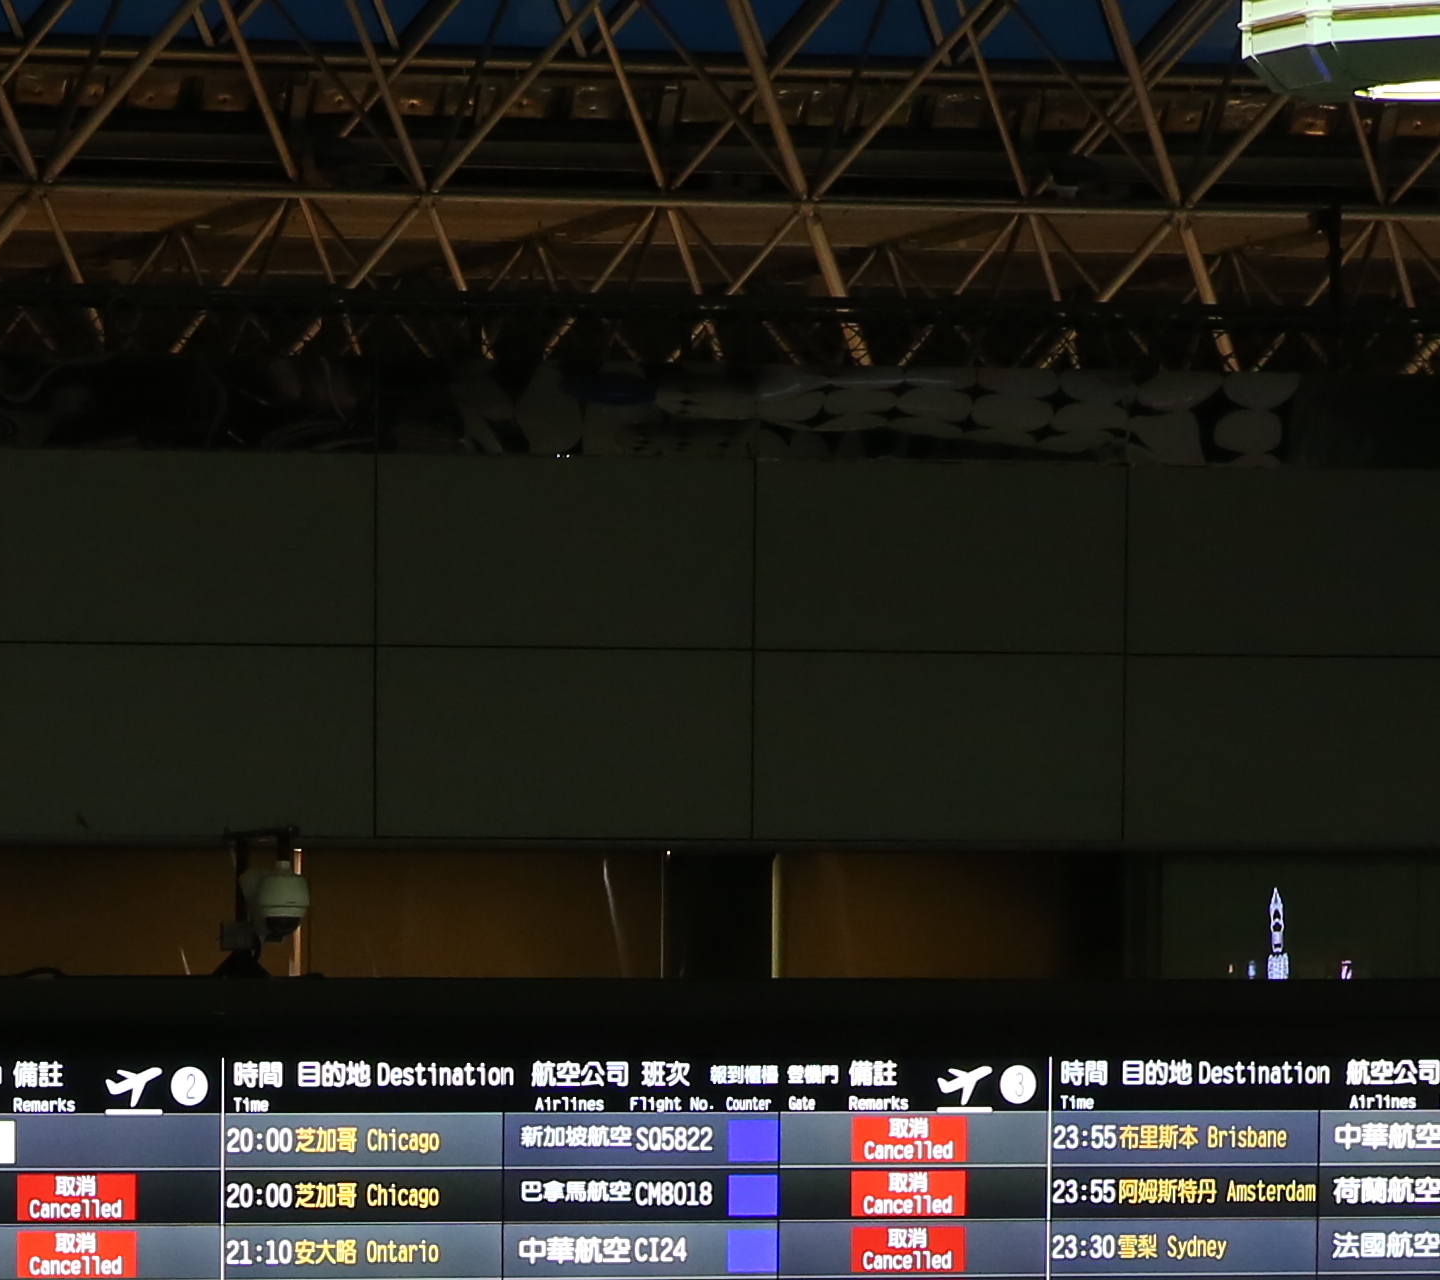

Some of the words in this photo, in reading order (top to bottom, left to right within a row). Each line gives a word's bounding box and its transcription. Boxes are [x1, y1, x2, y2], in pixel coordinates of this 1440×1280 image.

[55, 1175, 96, 1196] 取消
[1053, 1179, 1115, 1203] 23:55
[1119, 1179, 1217, 1203] 阿姆斯特丹
[1227, 1180, 1316, 1201] Amsterdam
[30, 1199, 122, 1218] Cancelled
[888, 1228, 927, 1248] 取消
[227, 1240, 292, 1264] 21:10
[295, 1239, 356, 1264] 安大略
[367, 1240, 438, 1262] Ontario
[519, 1236, 631, 1264] 中華航空
[635, 1237, 687, 1262] CI24
[863, 1251, 952, 1270] Cancelled
